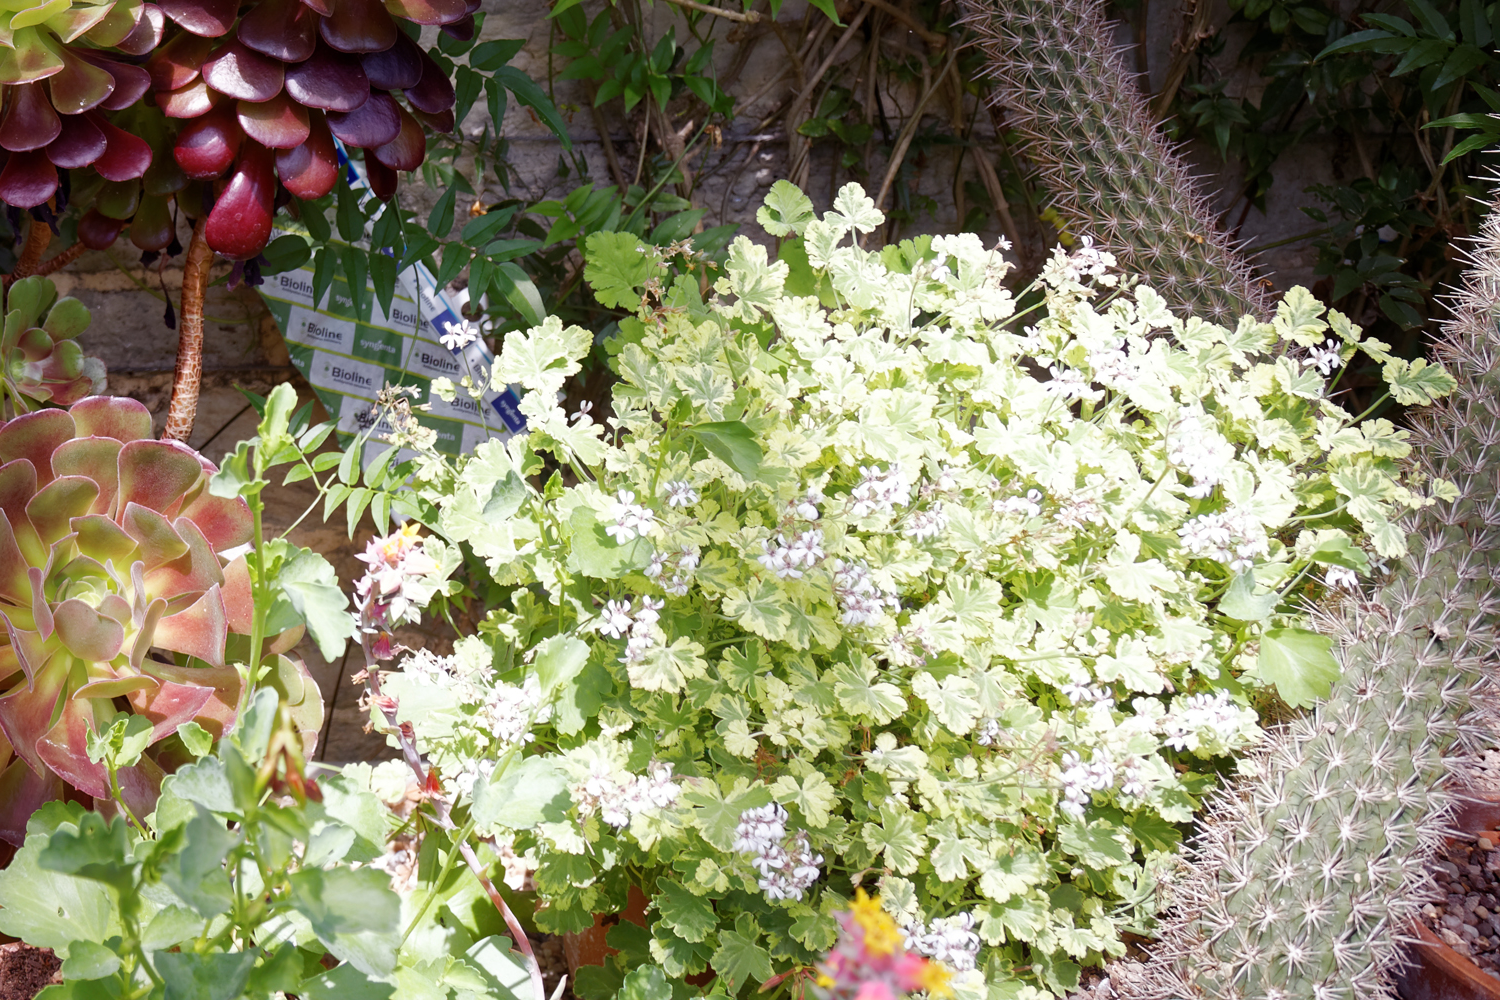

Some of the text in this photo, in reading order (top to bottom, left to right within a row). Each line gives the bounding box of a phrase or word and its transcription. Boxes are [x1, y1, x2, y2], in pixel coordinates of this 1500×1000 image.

[280, 276, 313, 294] Biolin
[307, 322, 343, 341] Bioline
[360, 339, 396, 354] syngenta
[421, 353, 460, 372] Bioline
[331, 367, 373, 386] Bioline
[359, 411, 393, 430] Bioin
